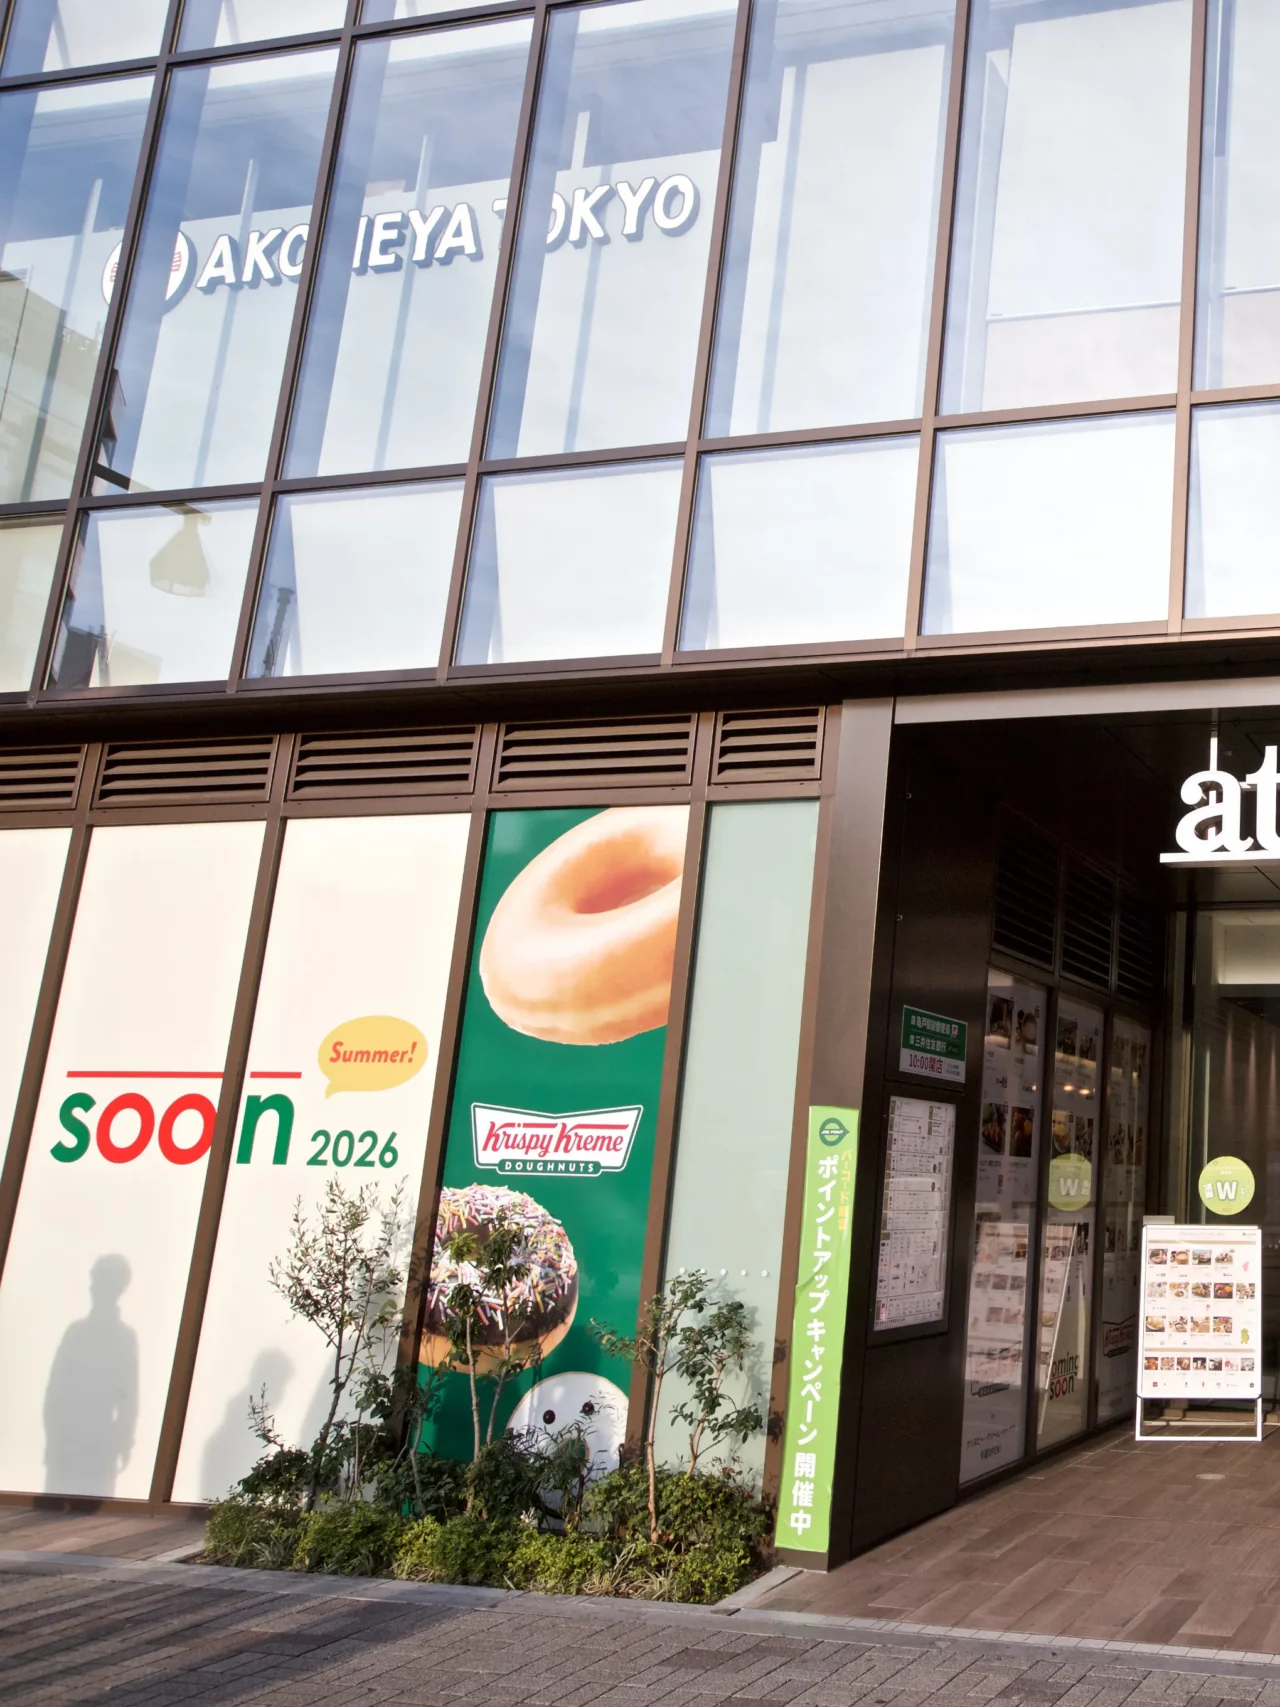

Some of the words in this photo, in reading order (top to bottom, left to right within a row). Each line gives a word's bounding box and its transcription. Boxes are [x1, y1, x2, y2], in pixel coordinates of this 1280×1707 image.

[196, 203, 477, 288] AKOEYA
[328, 1041, 418, 1064] Summer!
[50, 1092, 295, 1166] soon
[306, 1129, 399, 1169] 2026
[482, 1121, 559, 1158] Krispy
[553, 1122, 629, 1154] Kreme
[504, 1161, 595, 1173] DOUGHNUTS
[1050, 1375, 1074, 1400] soon
